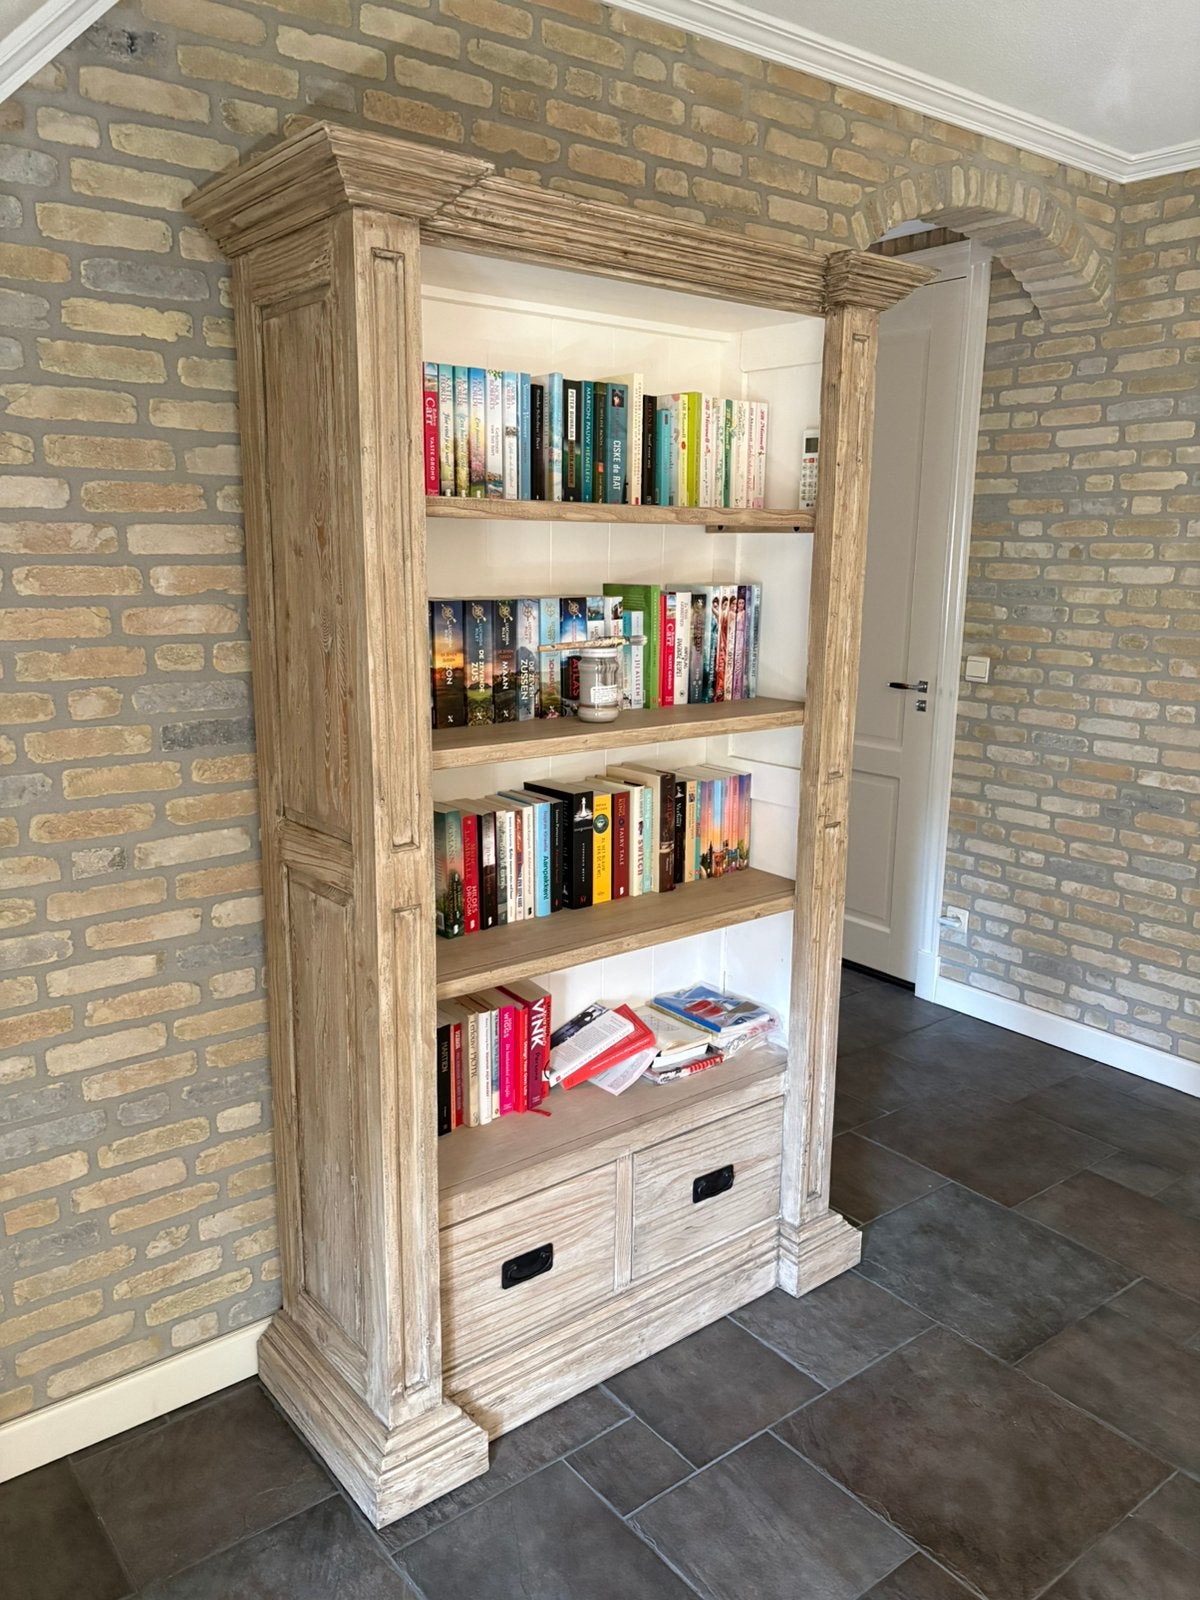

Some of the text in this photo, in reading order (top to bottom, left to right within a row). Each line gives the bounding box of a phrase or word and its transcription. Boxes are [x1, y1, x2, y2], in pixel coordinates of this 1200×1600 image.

[426, 397, 435, 426] Carr
[613, 440, 621, 490] CISKE de RAT
[666, 623, 674, 647] Carr
[479, 649, 485, 659] DE
[529, 661, 535, 671] DE
[572, 659, 580, 697] ATLAS
[531, 998, 545, 1050] VINK
